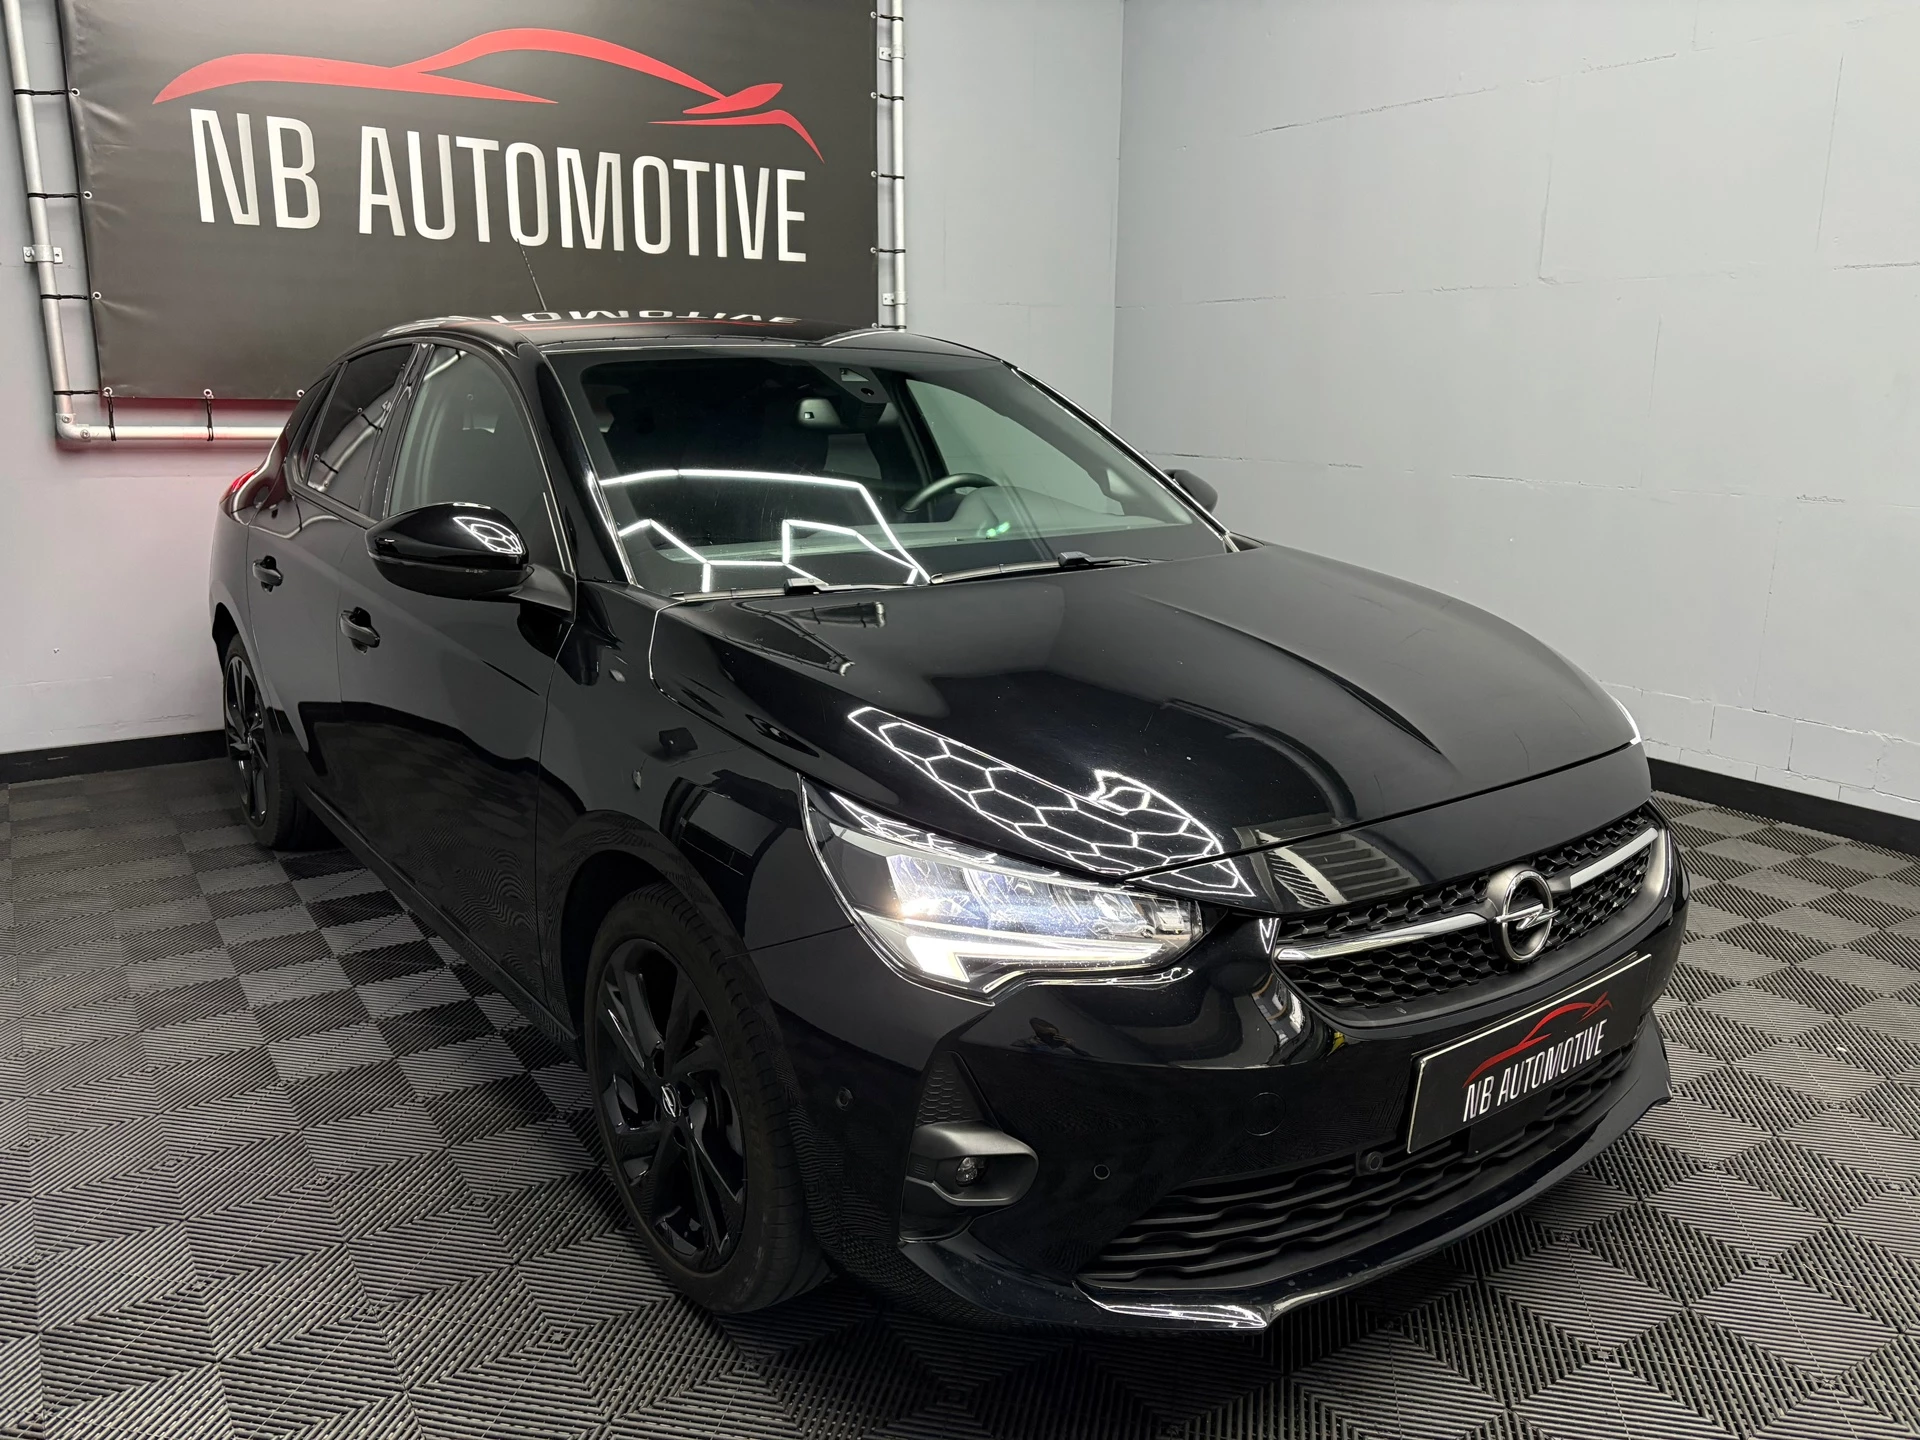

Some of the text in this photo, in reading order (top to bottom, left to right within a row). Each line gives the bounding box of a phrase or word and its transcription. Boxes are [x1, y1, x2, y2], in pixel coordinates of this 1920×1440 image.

[190, 108, 807, 263] NB AUTOMOTIVE
[1462, 1018, 1608, 1123] NB AUTOMOTIVE
